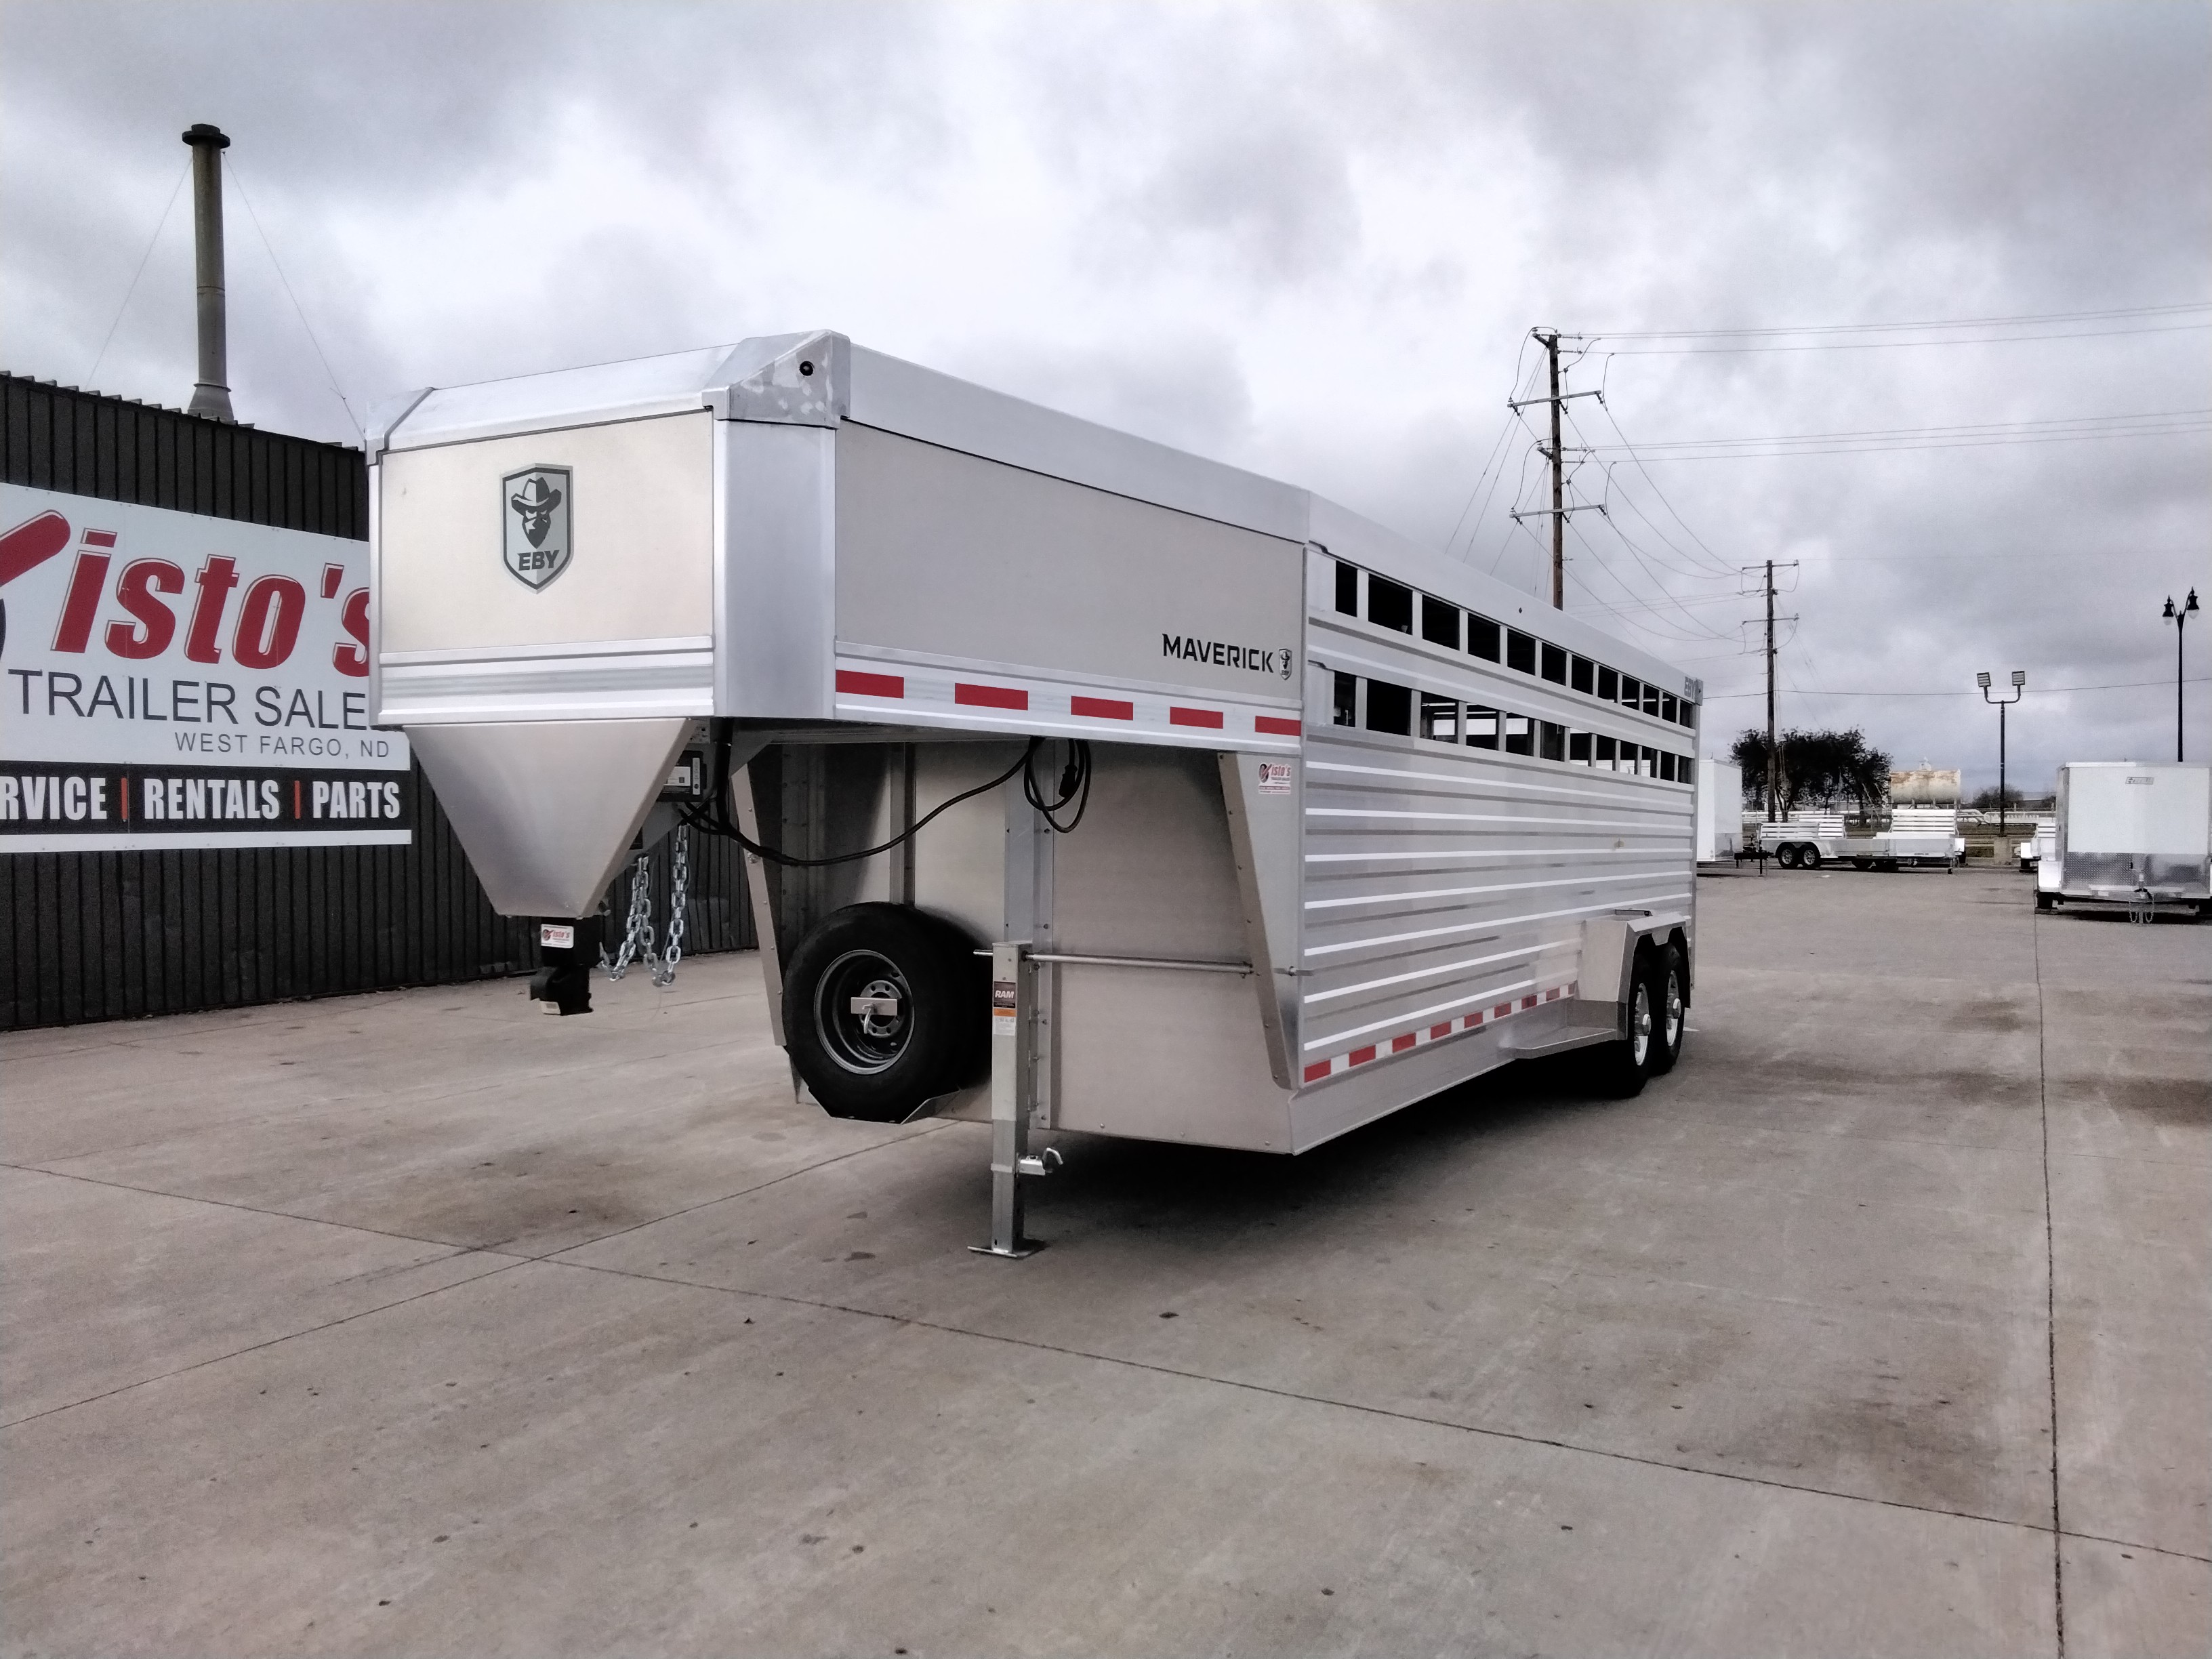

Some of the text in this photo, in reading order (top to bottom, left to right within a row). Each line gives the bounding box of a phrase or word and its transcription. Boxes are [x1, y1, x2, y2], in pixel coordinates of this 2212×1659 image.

[517, 550, 559, 571] EBY
[1162, 633, 1274, 673] MAVERICK
[8, 668, 370, 731] TRAILER SALE
[174, 732, 390, 759] WEST FARGO, ND
[144, 778, 280, 820] RENTALS
[312, 781, 401, 819] PARTS
[995, 990, 1015, 998] RAM
